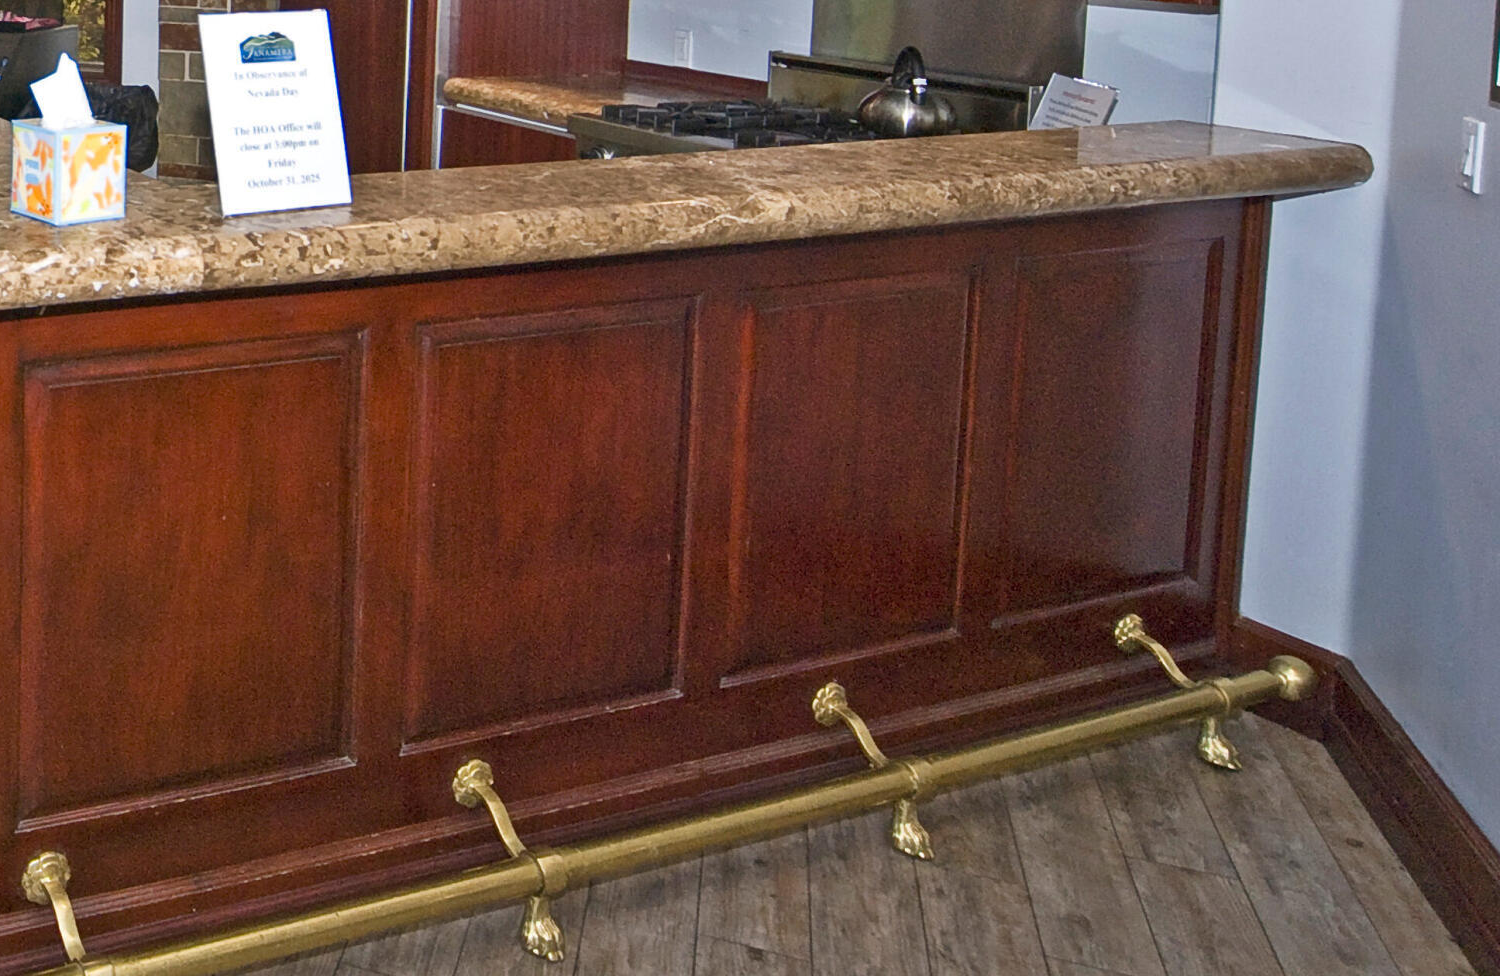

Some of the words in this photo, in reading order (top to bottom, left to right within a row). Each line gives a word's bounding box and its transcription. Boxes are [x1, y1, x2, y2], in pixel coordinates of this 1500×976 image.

[234, 71, 244, 80] In
[246, 70, 296, 80] Observance
[298, 68, 308, 77] of
[247, 89, 280, 98] Nevada
[282, 87, 299, 98] Day
[234, 126, 250, 136] The
[253, 124, 276, 135] HOA
[278, 123, 304, 134] Office
[306, 121, 322, 131] will
[240, 142, 261, 152] close
[264, 141, 272, 150] at
[274, 139, 307, 152] 3:00pm
[309, 139, 320, 148] on
[268, 159, 297, 171] Friday
[247, 178, 283, 190] October
[301, 174, 321, 185] 2025
